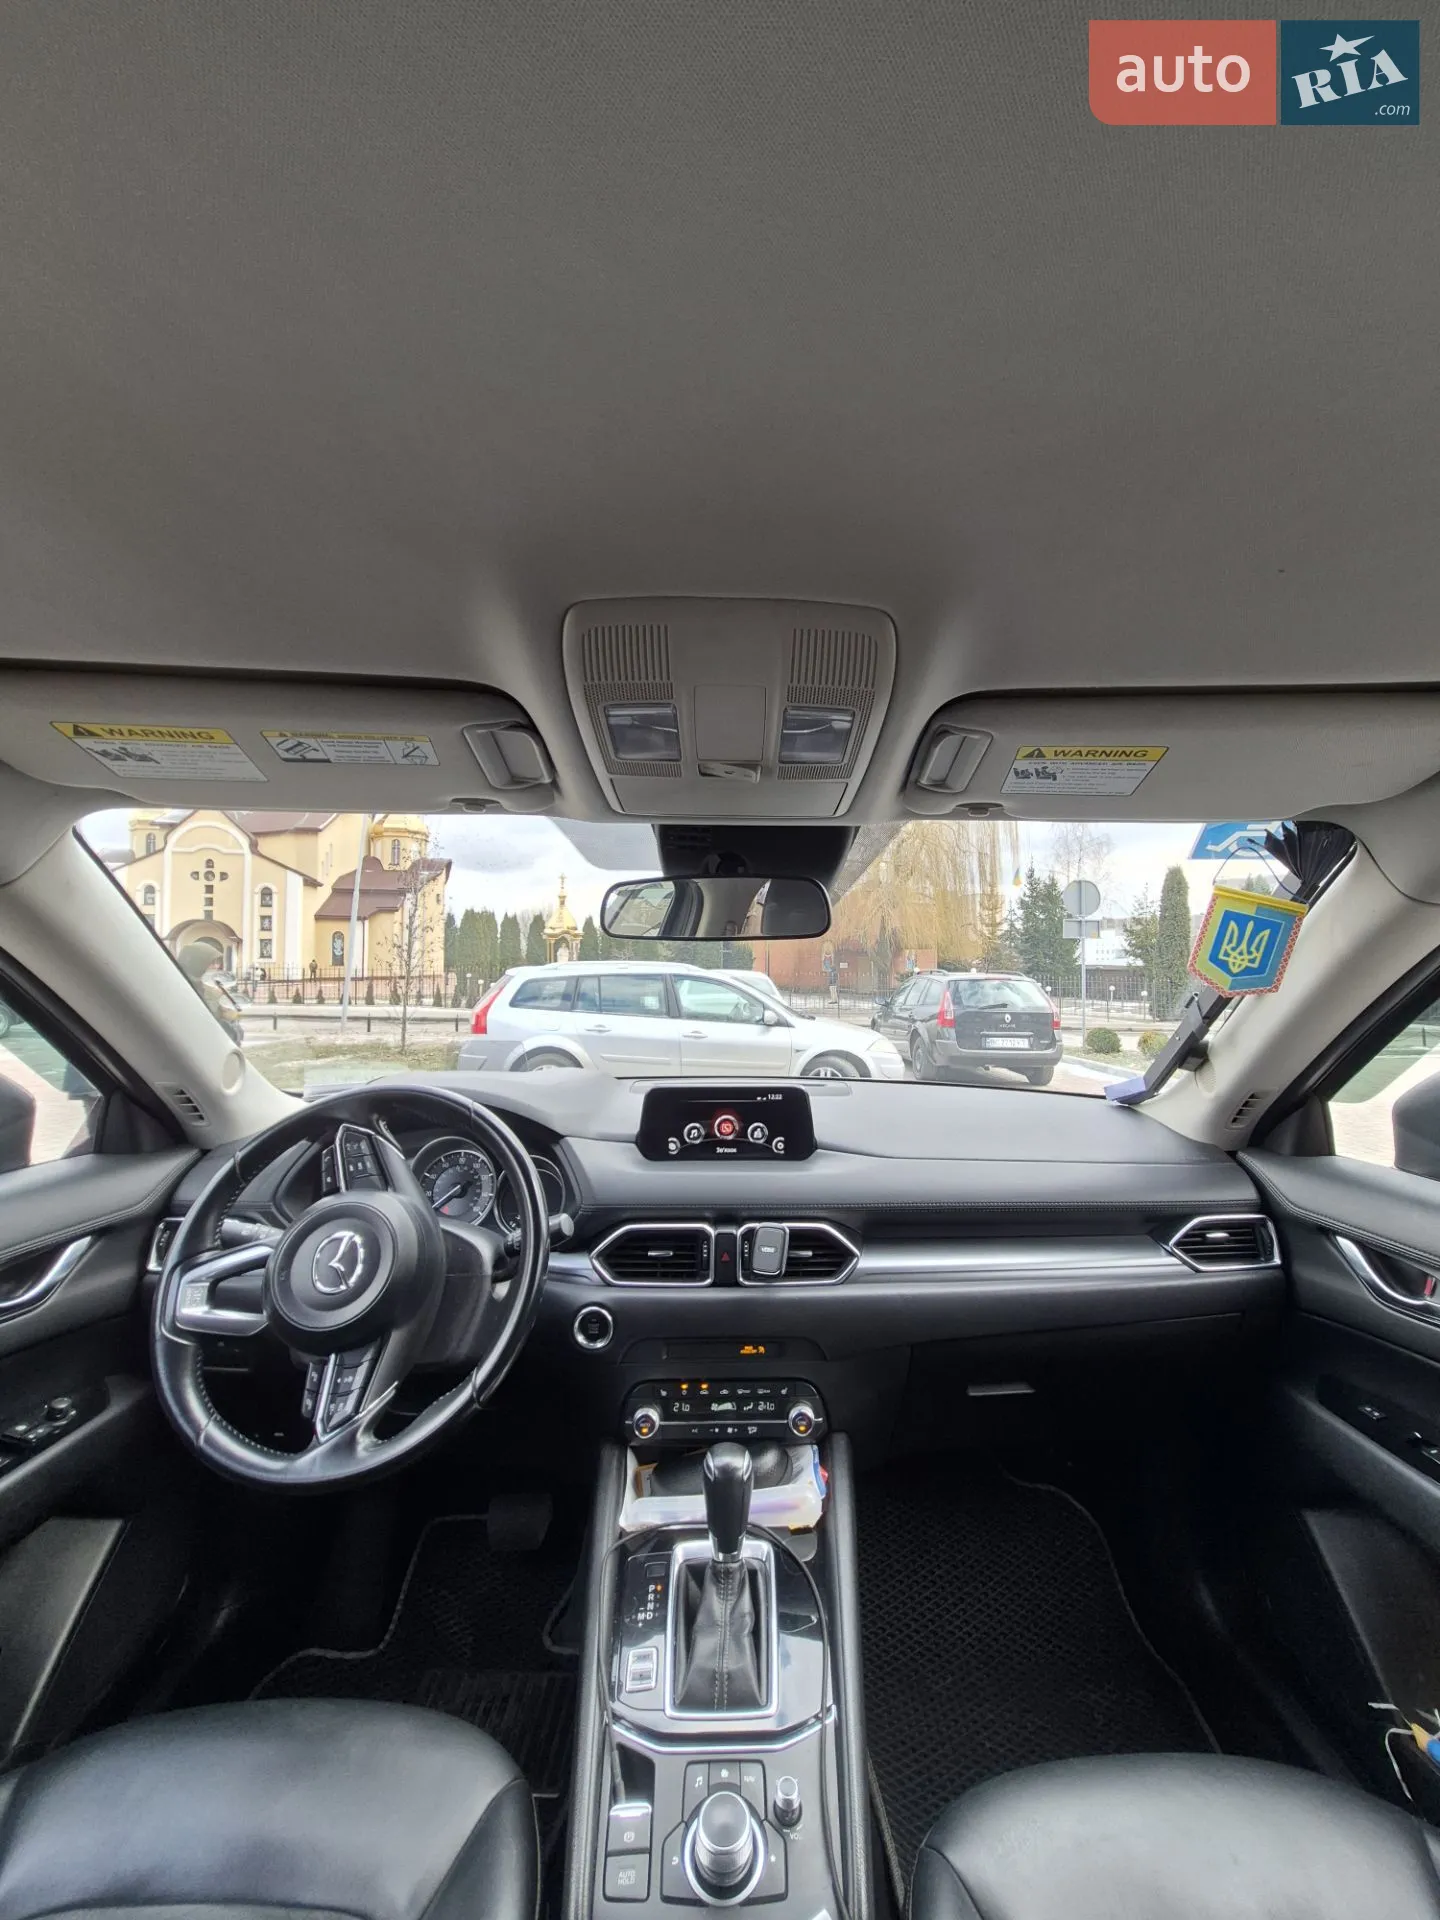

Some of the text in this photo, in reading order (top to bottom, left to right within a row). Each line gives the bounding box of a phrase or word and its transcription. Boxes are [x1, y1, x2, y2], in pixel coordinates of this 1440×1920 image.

[99, 727, 215, 740] WARNING
[1053, 749, 1149, 758] WARNING
[648, 1584, 655, 1592] P
[648, 1593, 655, 1601] R
[647, 1602, 654, 1610] N
[646, 1612, 653, 1620] D
[618, 1870, 636, 1878] AUTO
[617, 1877, 636, 1885] HOLD
